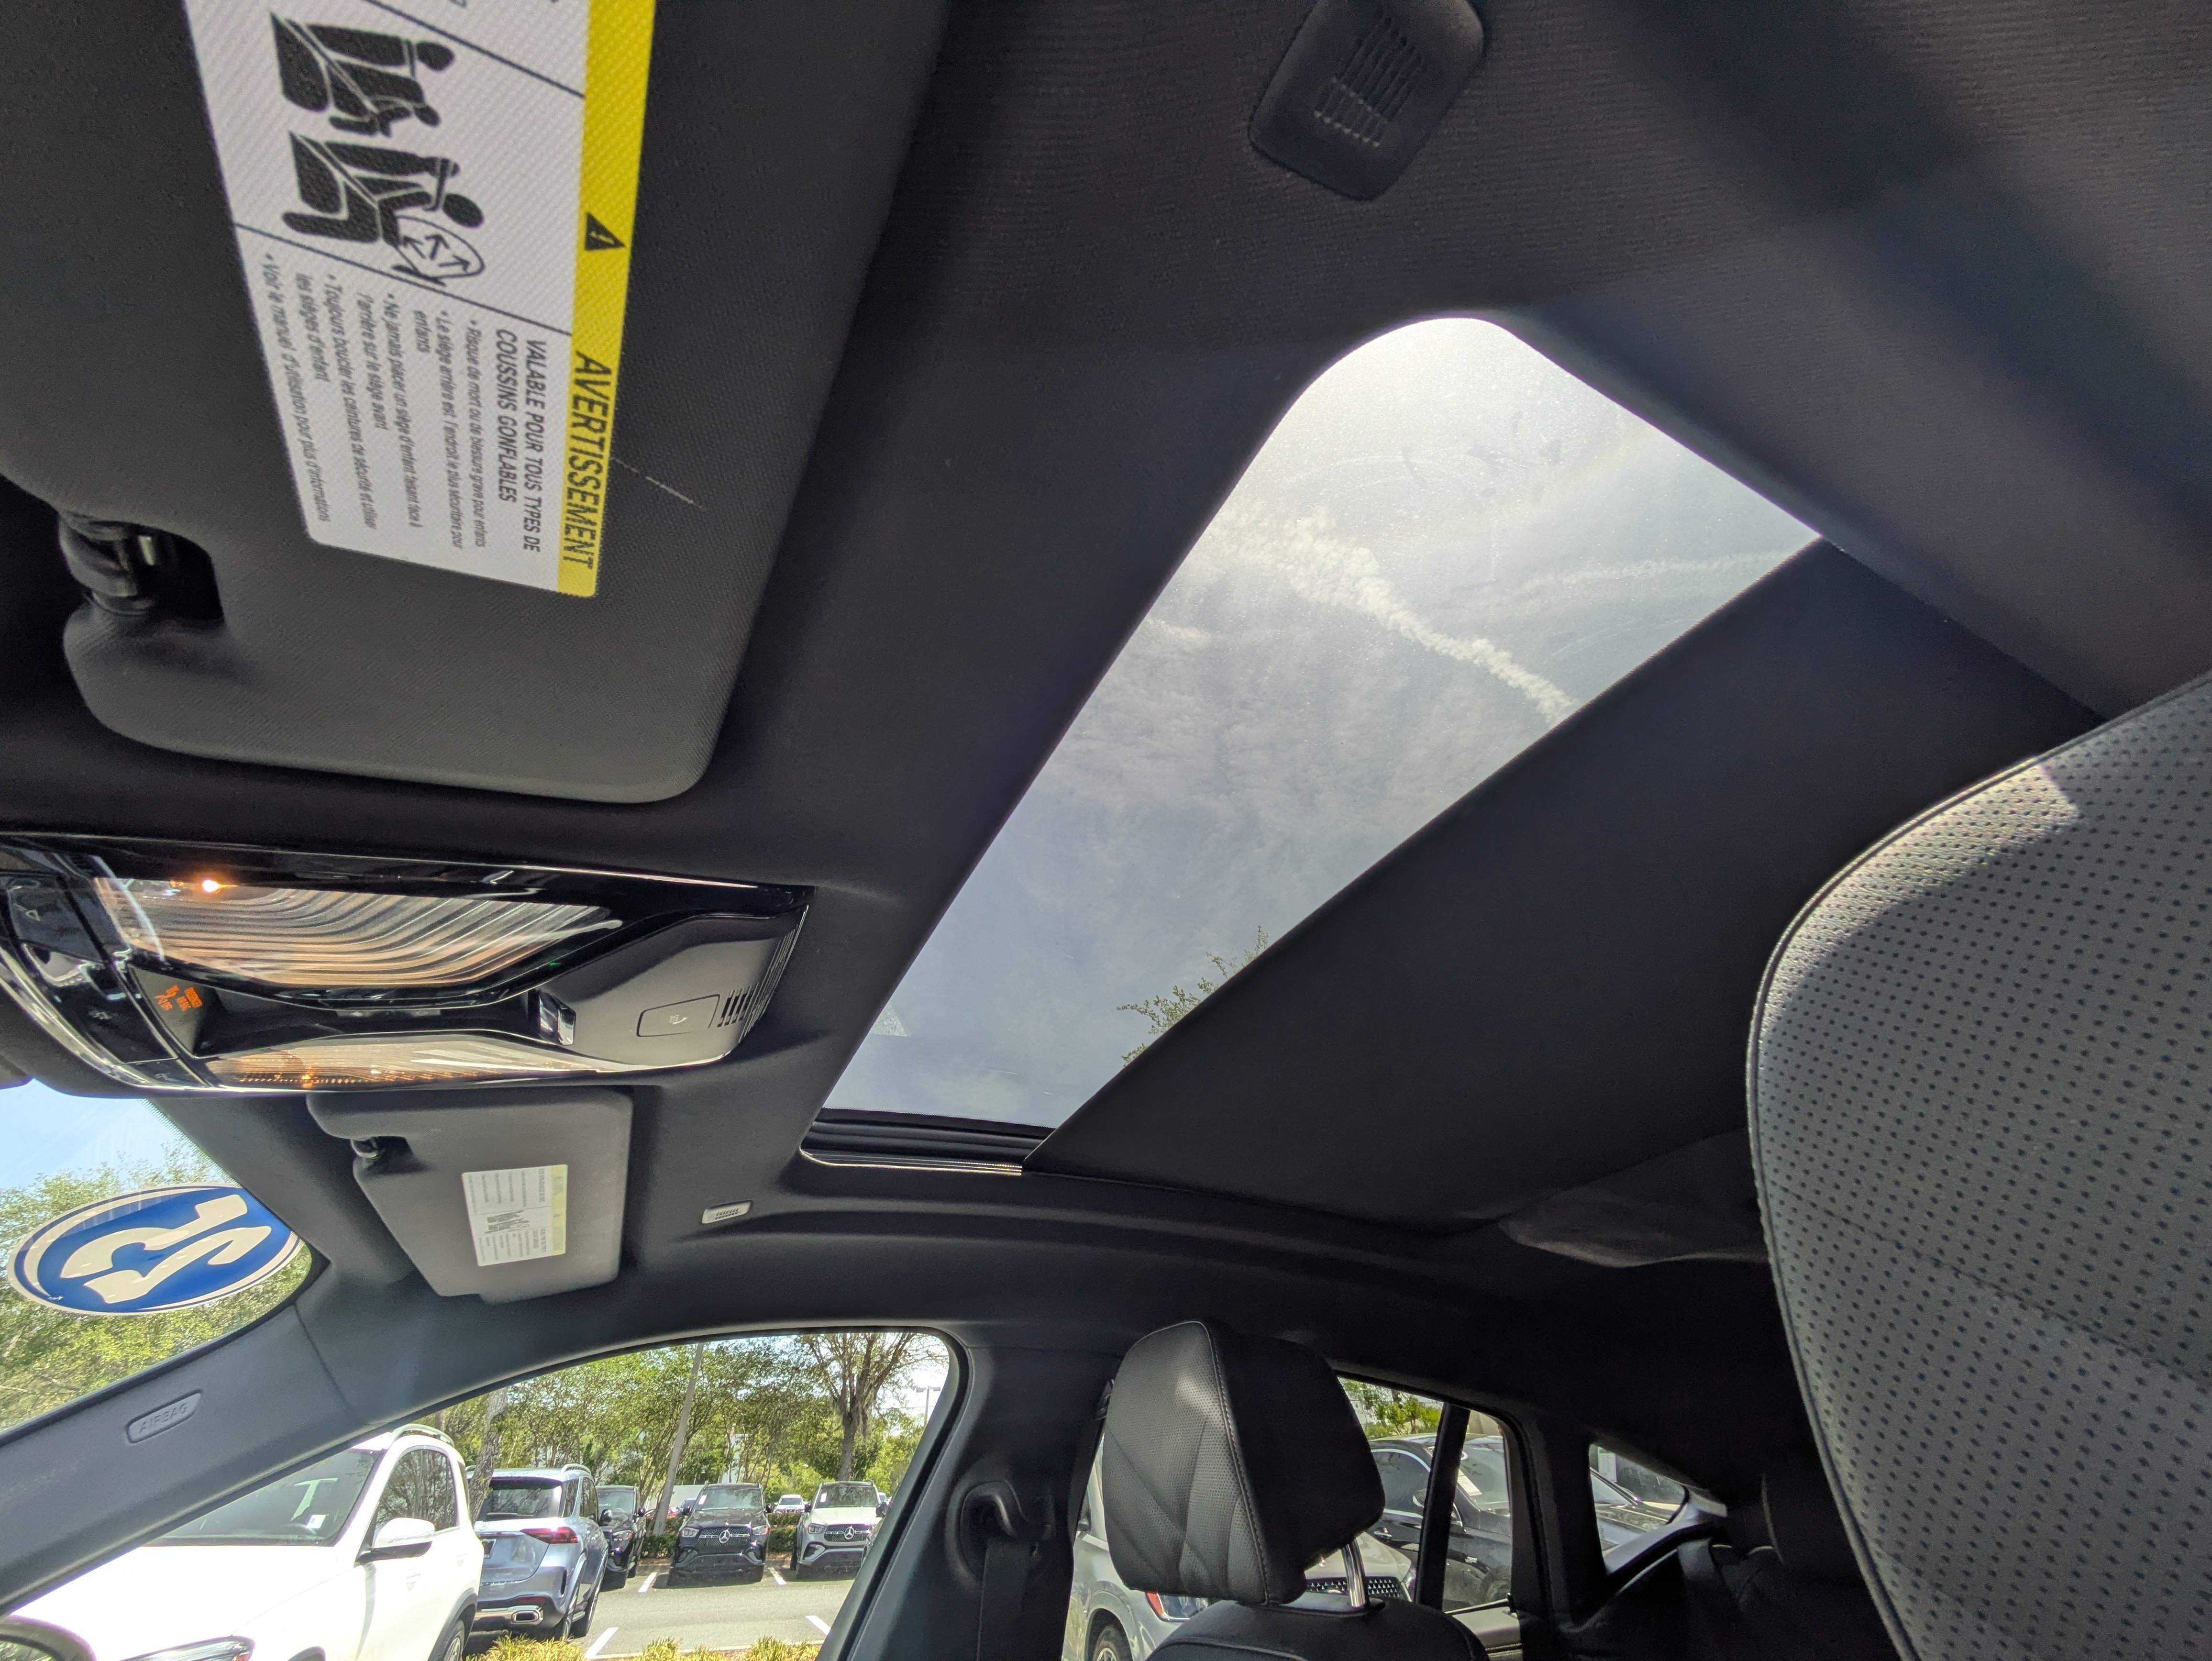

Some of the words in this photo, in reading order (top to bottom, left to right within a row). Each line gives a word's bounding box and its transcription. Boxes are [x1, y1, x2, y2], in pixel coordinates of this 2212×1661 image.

[495, 328, 518, 411] COUSSINS
[525, 339, 546, 410] VALABLE
[524, 410, 545, 453] POUR
[497, 415, 518, 503] GONFLABLES
[523, 456, 543, 491] TOUS
[563, 350, 612, 569] AVERTISSEMENT
[523, 496, 542, 533] TYPES
[522, 534, 541, 553] DE
[138, 1403, 188, 1433] AIRBAG
